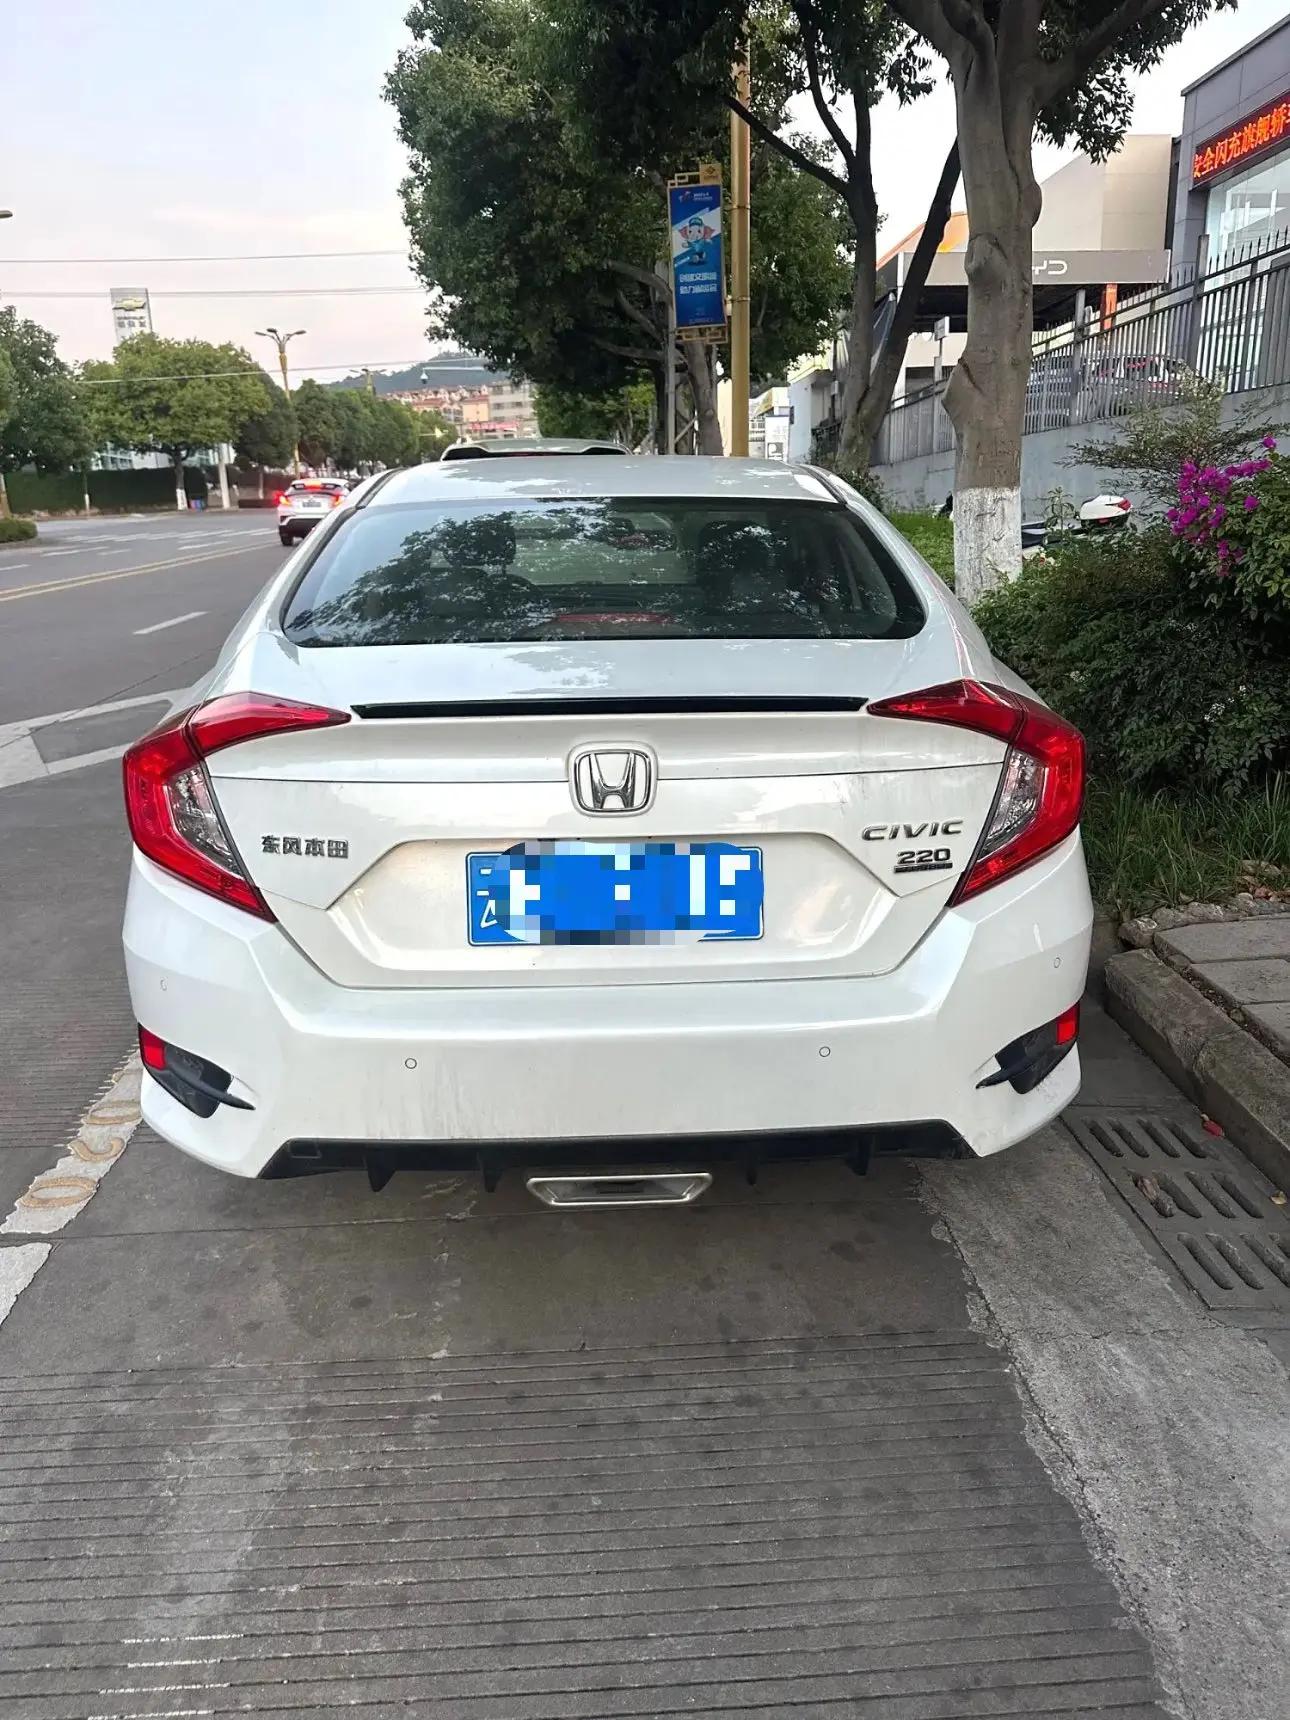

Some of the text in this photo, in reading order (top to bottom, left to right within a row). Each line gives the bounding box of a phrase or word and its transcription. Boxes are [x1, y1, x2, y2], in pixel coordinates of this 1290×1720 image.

[1193, 103, 1290, 178] 安全闪充旗舰轿
[1032, 259, 1068, 276] YD
[862, 819, 964, 841] CIVIC
[261, 834, 349, 859] 东风本田
[897, 848, 951, 864] 220
